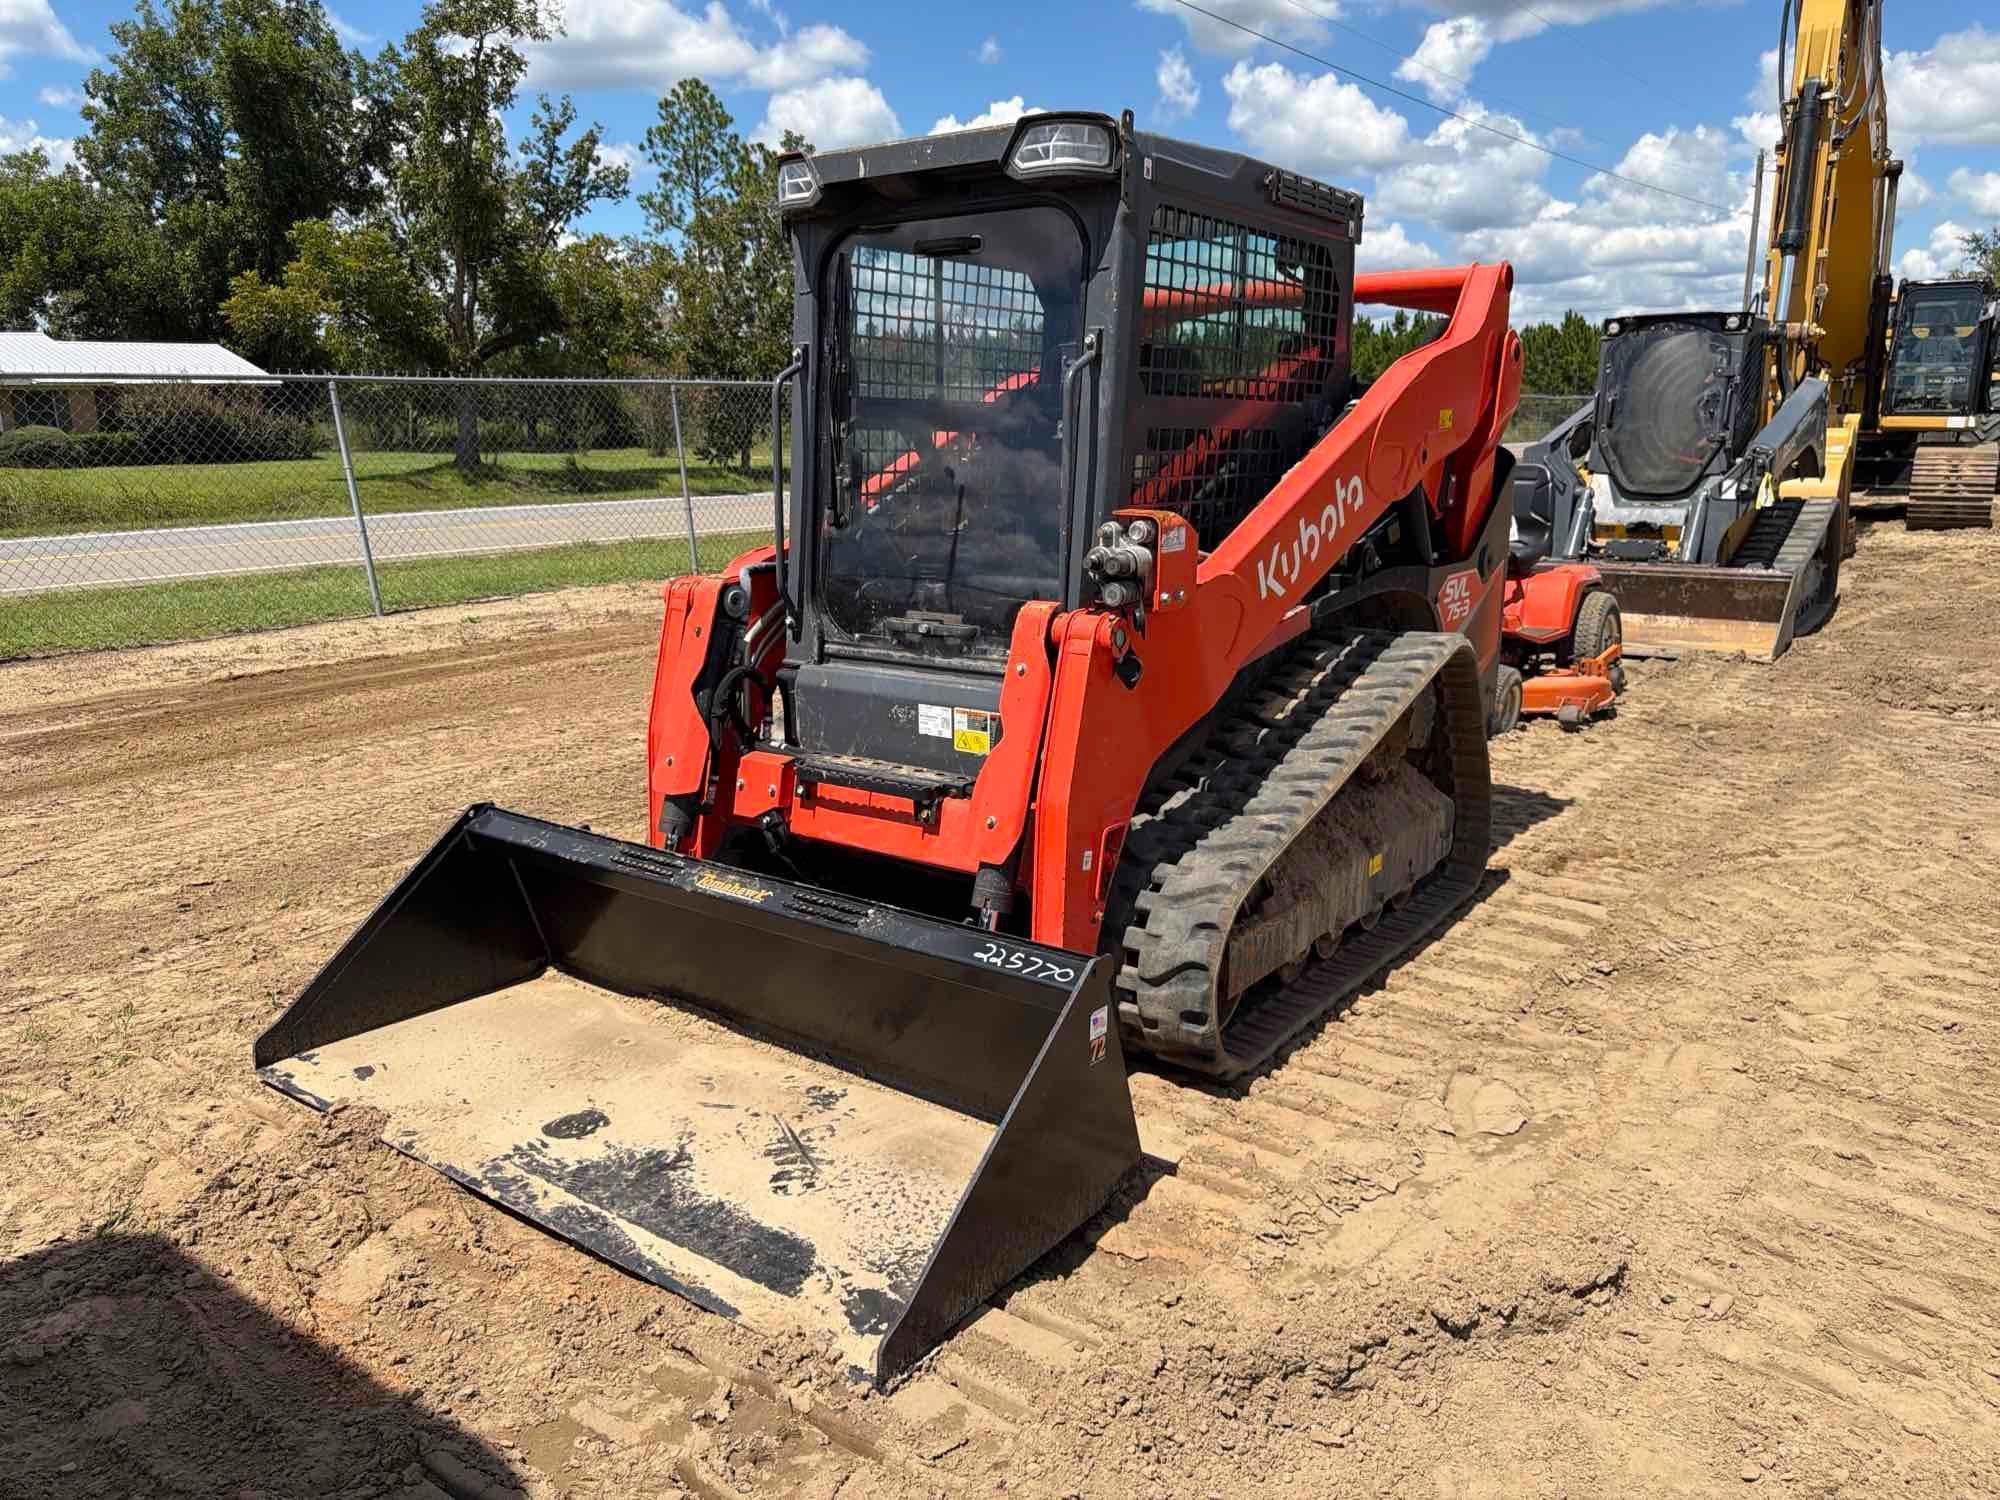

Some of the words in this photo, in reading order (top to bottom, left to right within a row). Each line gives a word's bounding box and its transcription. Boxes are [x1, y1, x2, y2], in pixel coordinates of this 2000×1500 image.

[1257, 474, 1364, 600] Kubota
[1443, 577, 1470, 603] SVL
[697, 870, 773, 902] Tomahawk
[973, 943, 1074, 982] 225770
